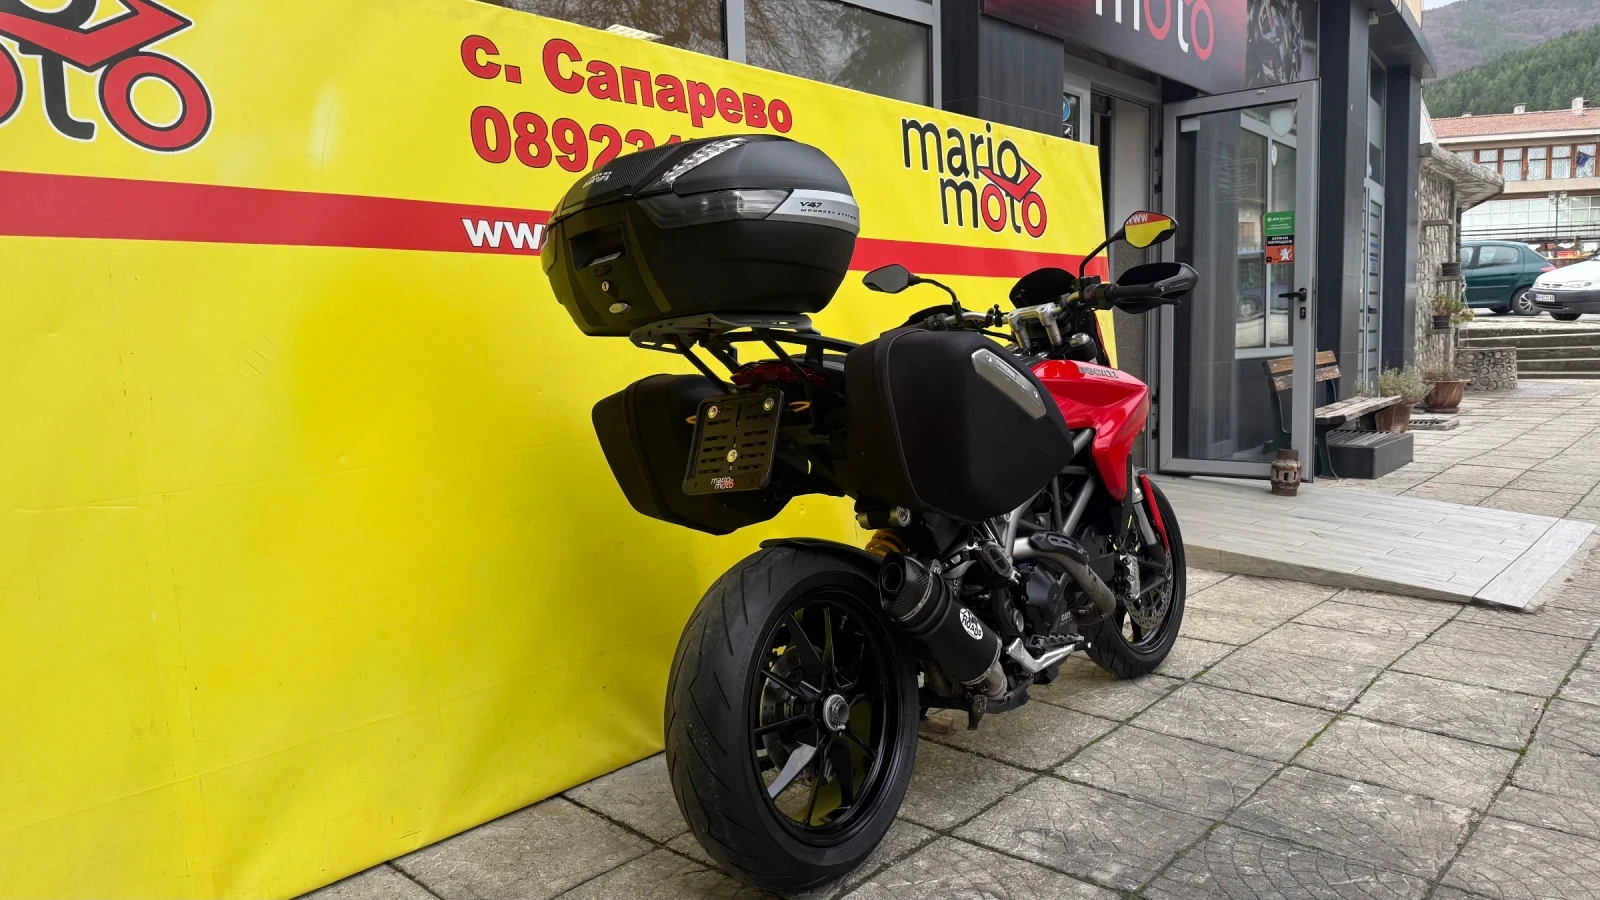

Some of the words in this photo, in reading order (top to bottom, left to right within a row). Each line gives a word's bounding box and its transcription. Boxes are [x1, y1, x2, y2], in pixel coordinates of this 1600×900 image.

[461, 35, 522, 84] с.
[542, 38, 792, 133] Сапарево
[901, 118, 1021, 184] mario
[939, 177, 1047, 238] moto
[1078, 365, 1119, 379] DUCATI
[711, 476, 731, 484] mario
